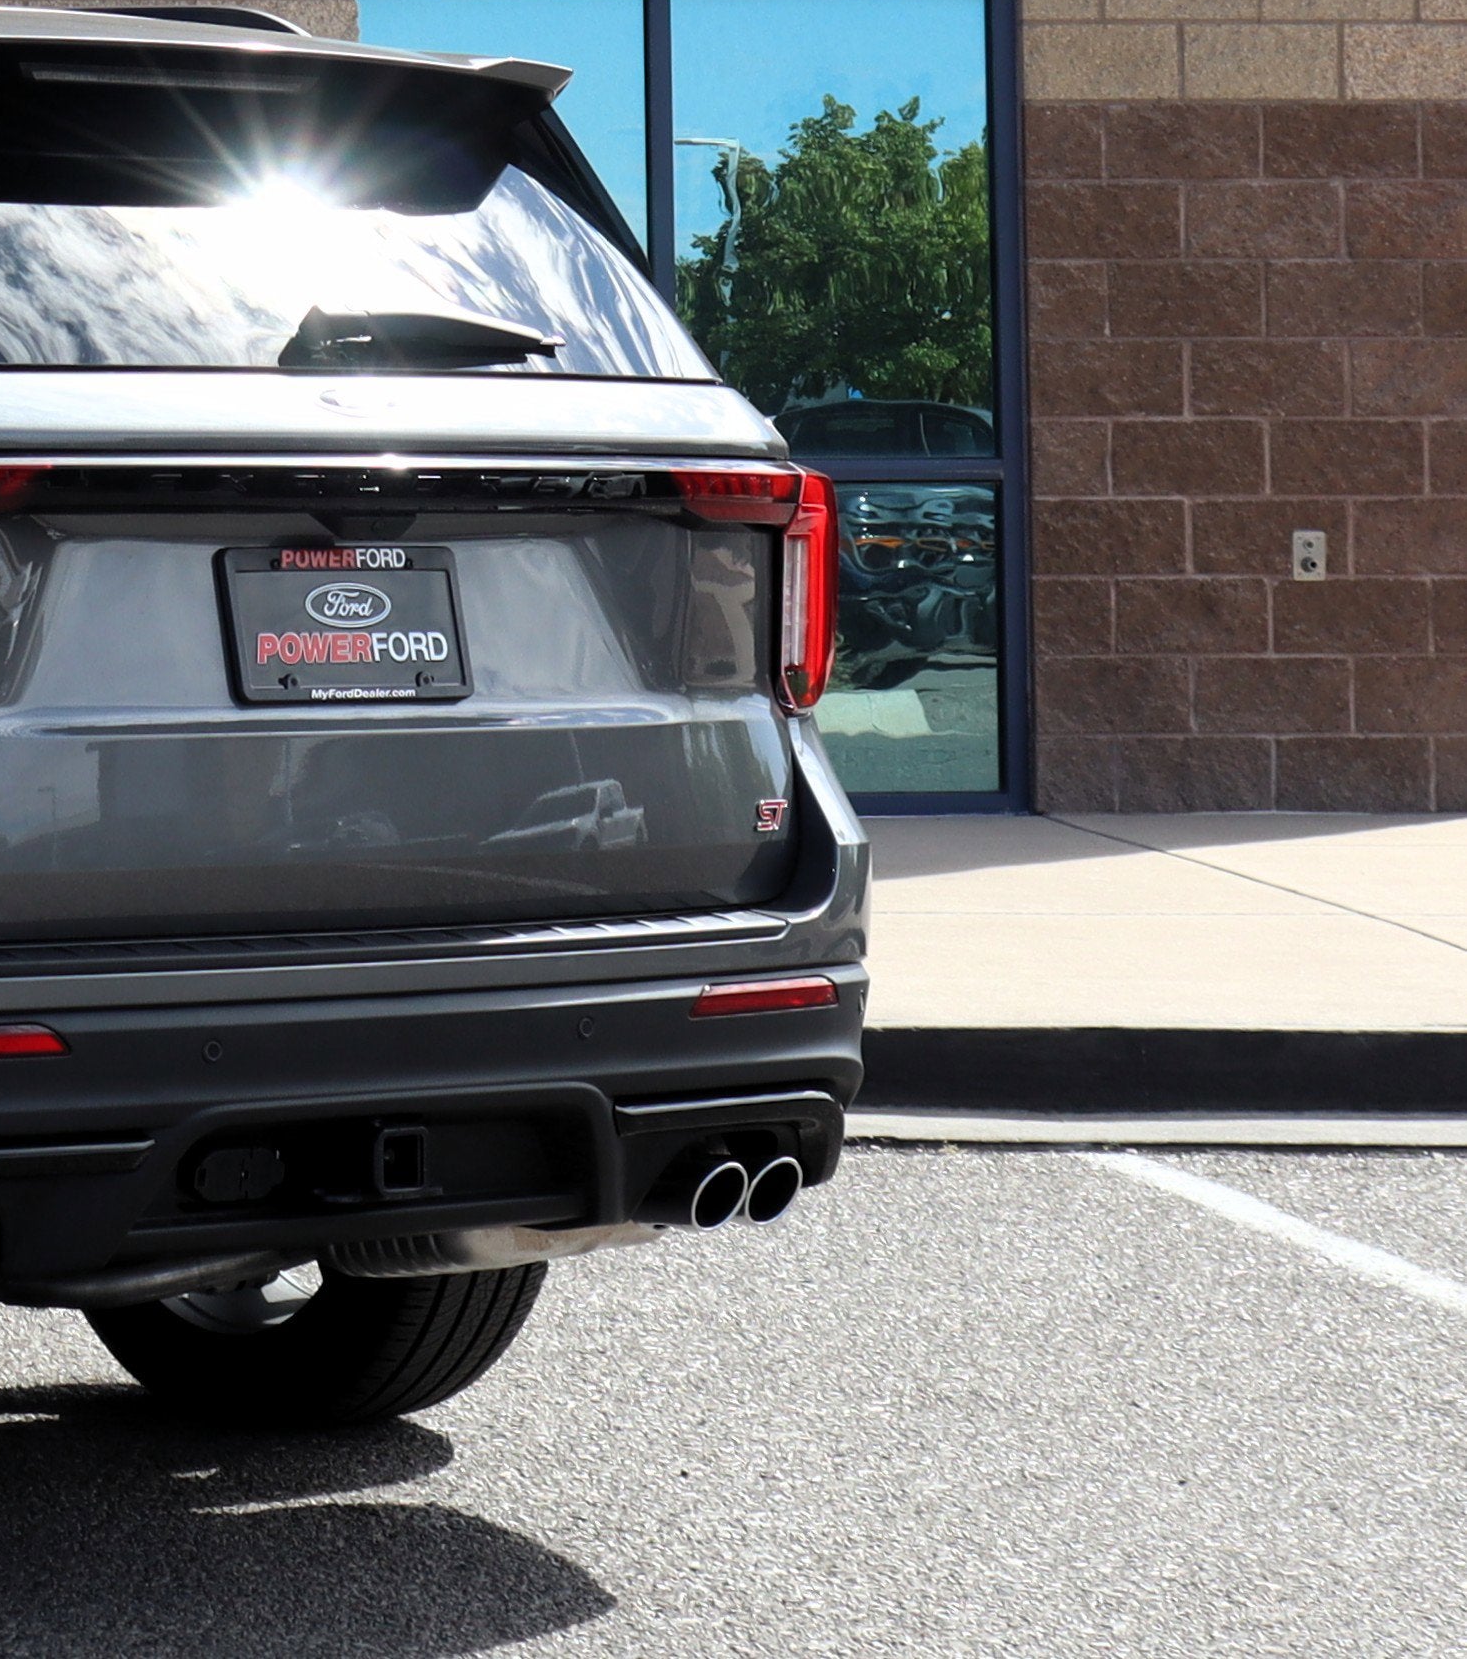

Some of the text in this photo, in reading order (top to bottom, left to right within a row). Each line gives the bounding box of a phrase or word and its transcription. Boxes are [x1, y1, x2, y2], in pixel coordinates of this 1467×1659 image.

[281, 548, 406, 569] POWERFORD
[323, 590, 373, 617] Ford
[257, 631, 448, 664] POWERFORD
[311, 688, 416, 700] MyFordDealer.com
[757, 799, 788, 831] ST
